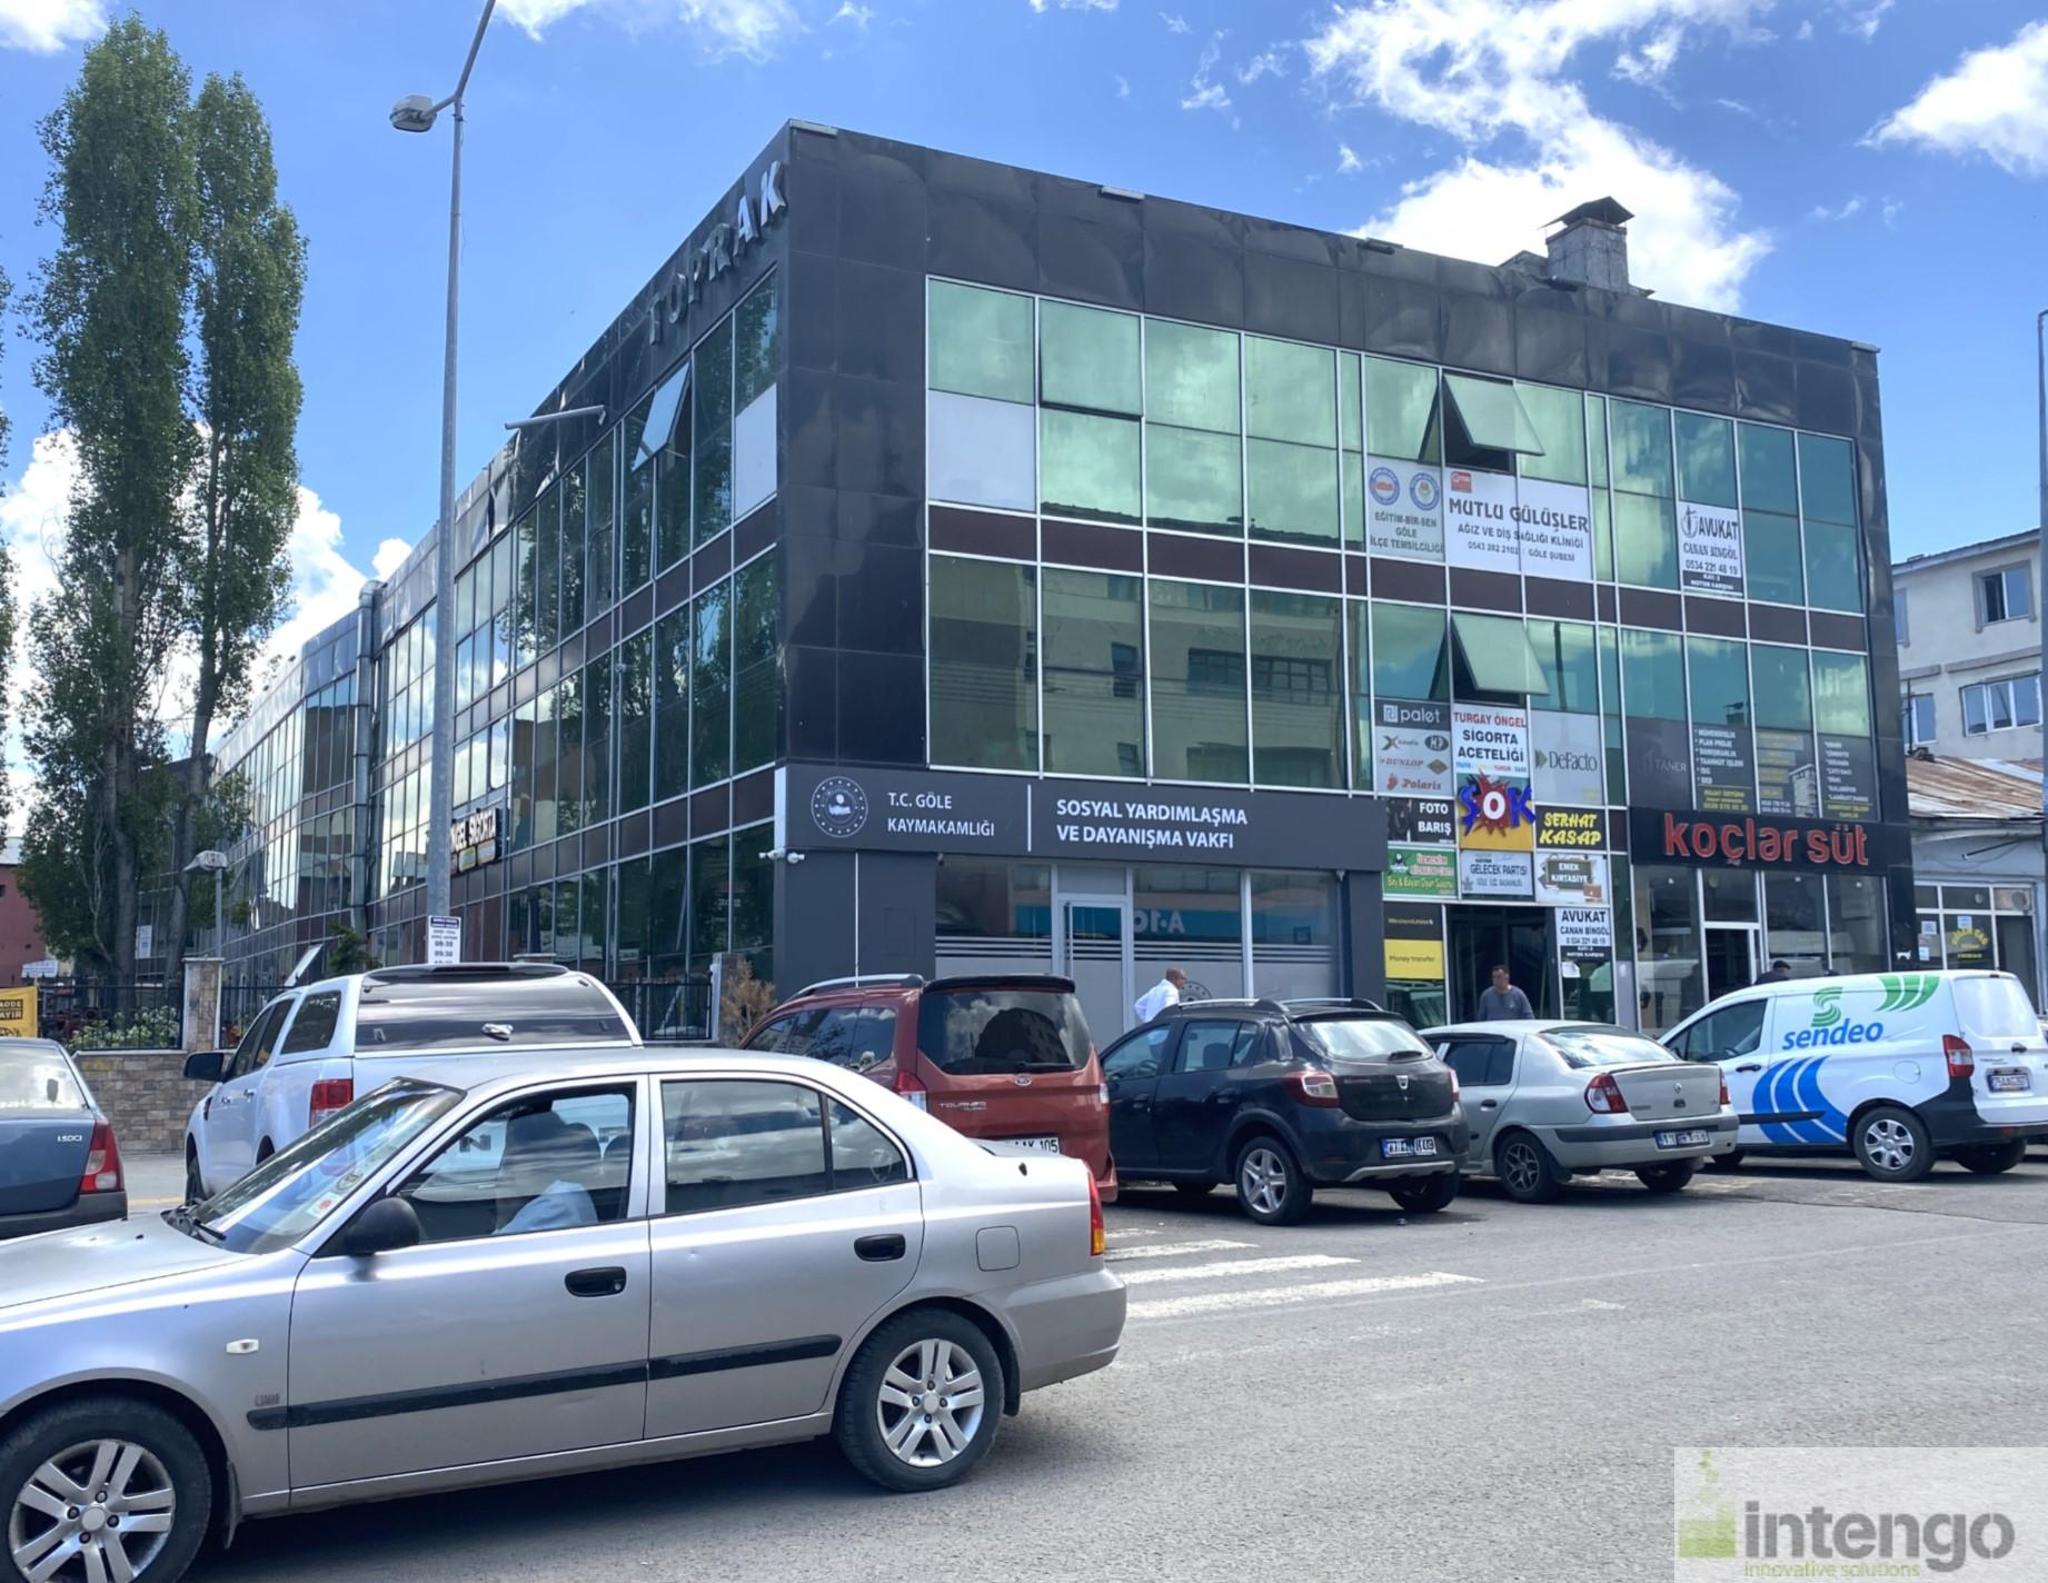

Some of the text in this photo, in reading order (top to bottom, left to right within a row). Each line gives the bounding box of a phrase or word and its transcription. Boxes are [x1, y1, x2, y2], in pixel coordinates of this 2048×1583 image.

[1449, 497, 1589, 533] MUTLU GÜLÜŞLER
[1458, 522, 1480, 536] AĞIZ
[1481, 526, 1495, 537] VE
[1496, 527, 1511, 541] DİŞ
[1551, 534, 1584, 549] KLİNİĞİ
[1699, 516, 1739, 540] AVUKAT
[1400, 706, 1440, 724] palet
[1454, 711, 1528, 728] TURGAY ÖNGEL
[1463, 727, 1519, 745] SİGORTA
[1458, 746, 1524, 762] ACETELİĞİ
[1549, 751, 1598, 771] DeFacto
[1402, 778, 1442, 790] Polaris
[888, 792, 953, 809] T.C. GÖLE
[1419, 802, 1449, 815] FOTO
[1056, 799, 1248, 827] SOSYAL YARDIMLAŞMA
[1544, 812, 1597, 828] SERHAT
[887, 817, 995, 837] KAYMAKAMLIĞI
[1418, 821, 1453, 836] BARIŞ
[1056, 825, 1234, 849] VE DAYANIŞMA VAKFI
[1539, 830, 1602, 845] KASAP
[1664, 812, 1869, 866] koçlar süt
[1471, 864, 1501, 876] GELECEK
[1561, 910, 1606, 922] AVUKAT
[1560, 926, 1583, 935] CANAN
[1782, 1018, 1884, 1050] sendeo
